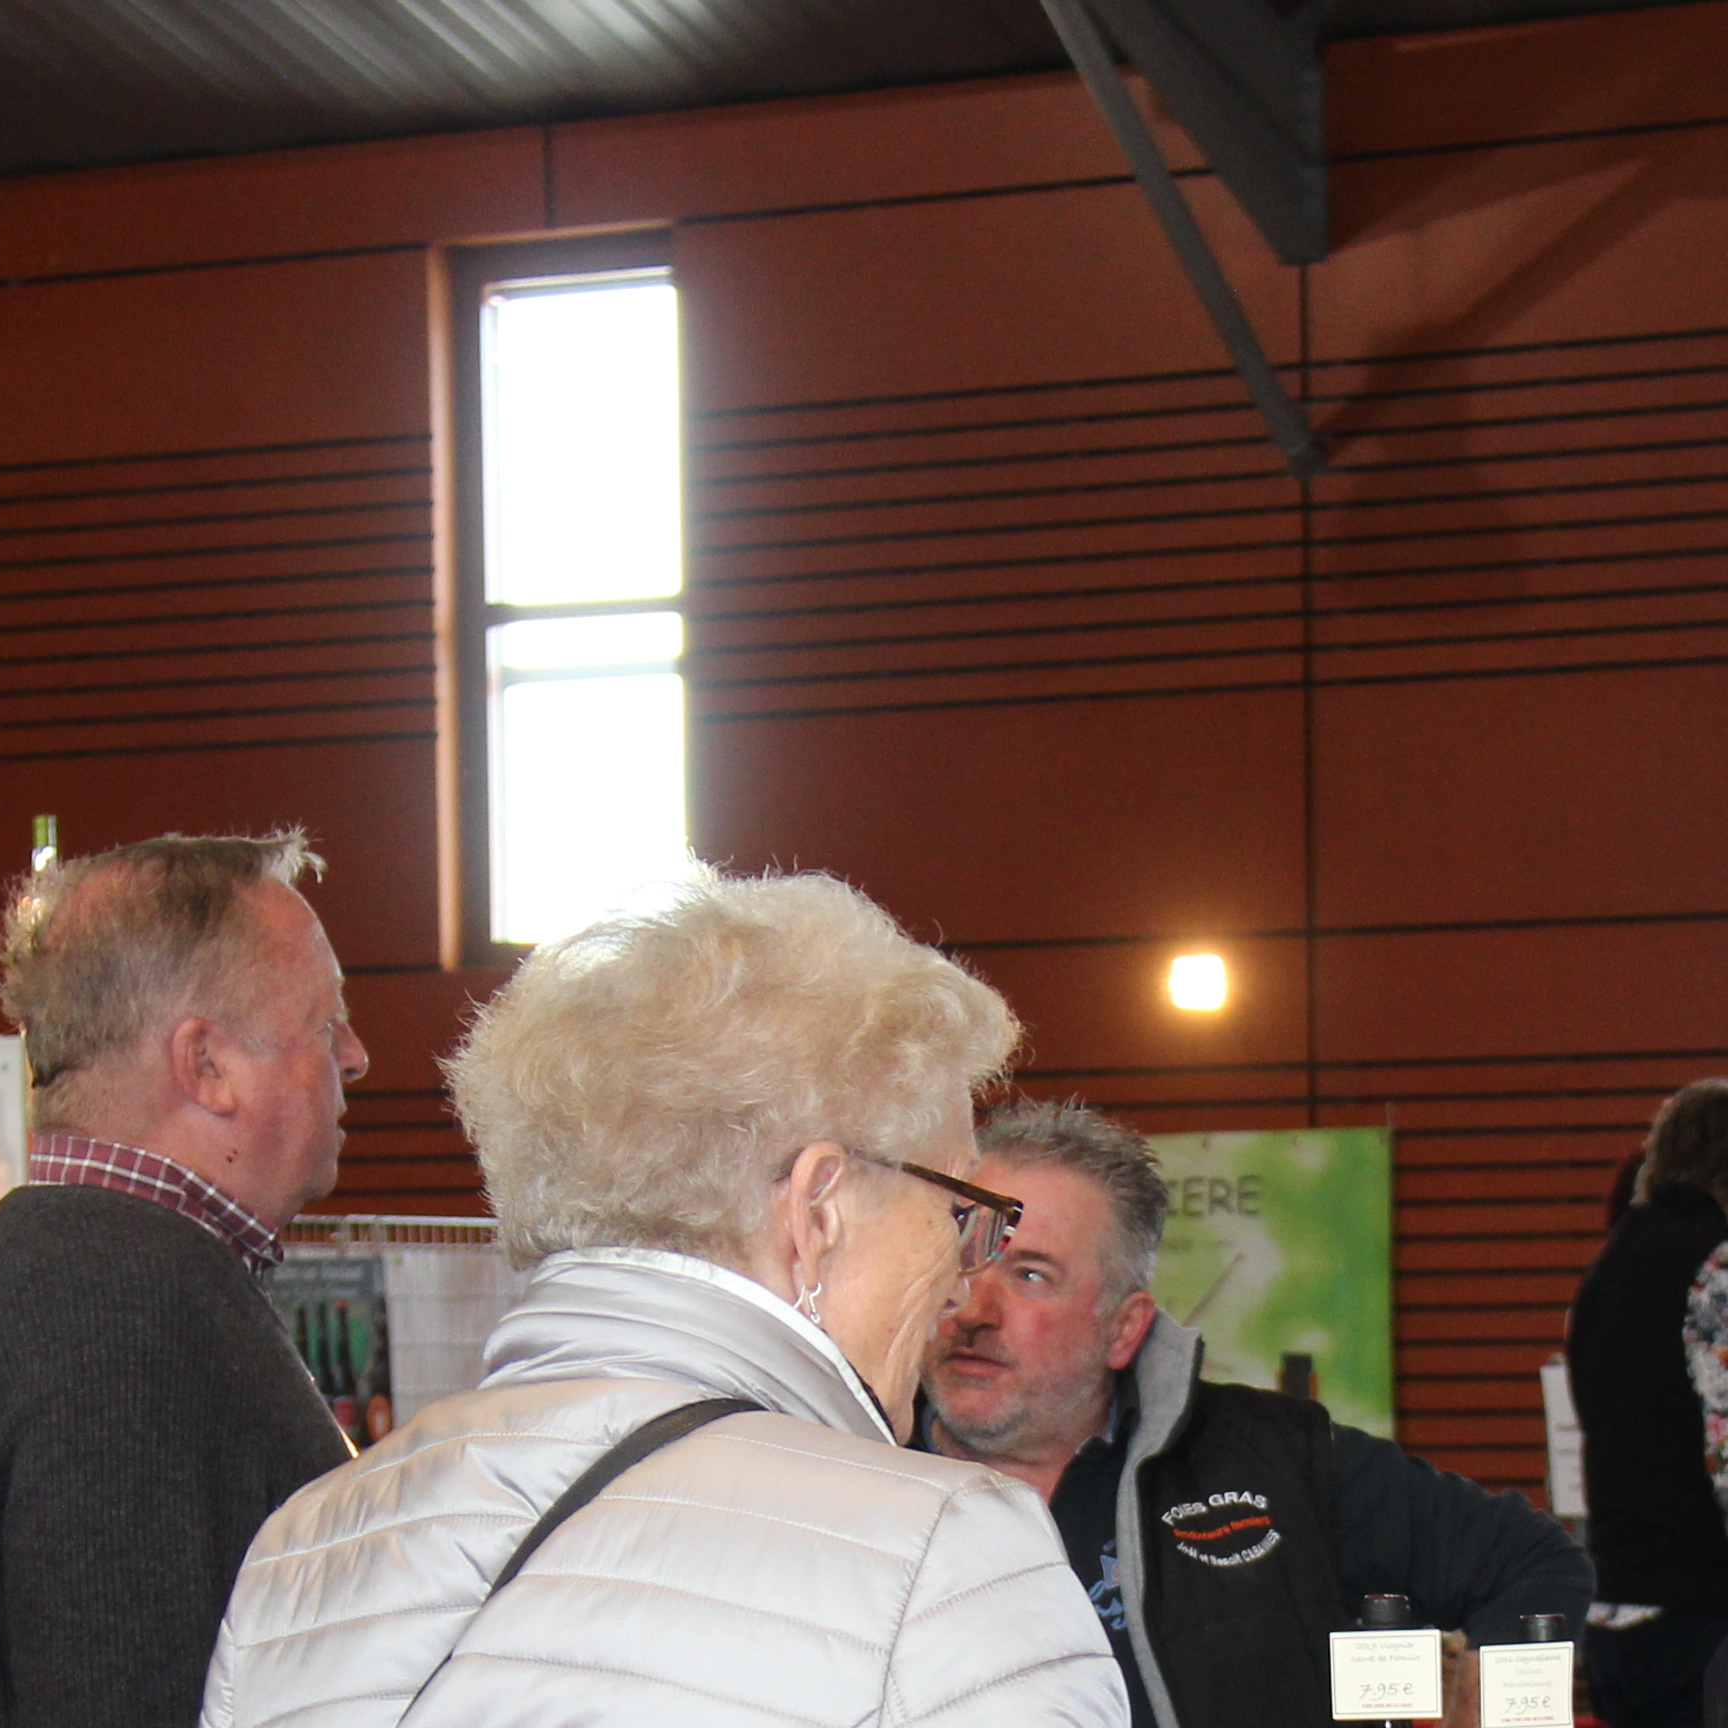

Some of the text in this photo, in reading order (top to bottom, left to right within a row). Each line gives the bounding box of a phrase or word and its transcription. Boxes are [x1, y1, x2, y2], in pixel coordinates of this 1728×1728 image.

[1161, 1491, 1268, 1526] FOIES GRAS
[1358, 1682, 1414, 1701] 7.95 €
[1505, 1695, 1551, 1715] 7.95 €
